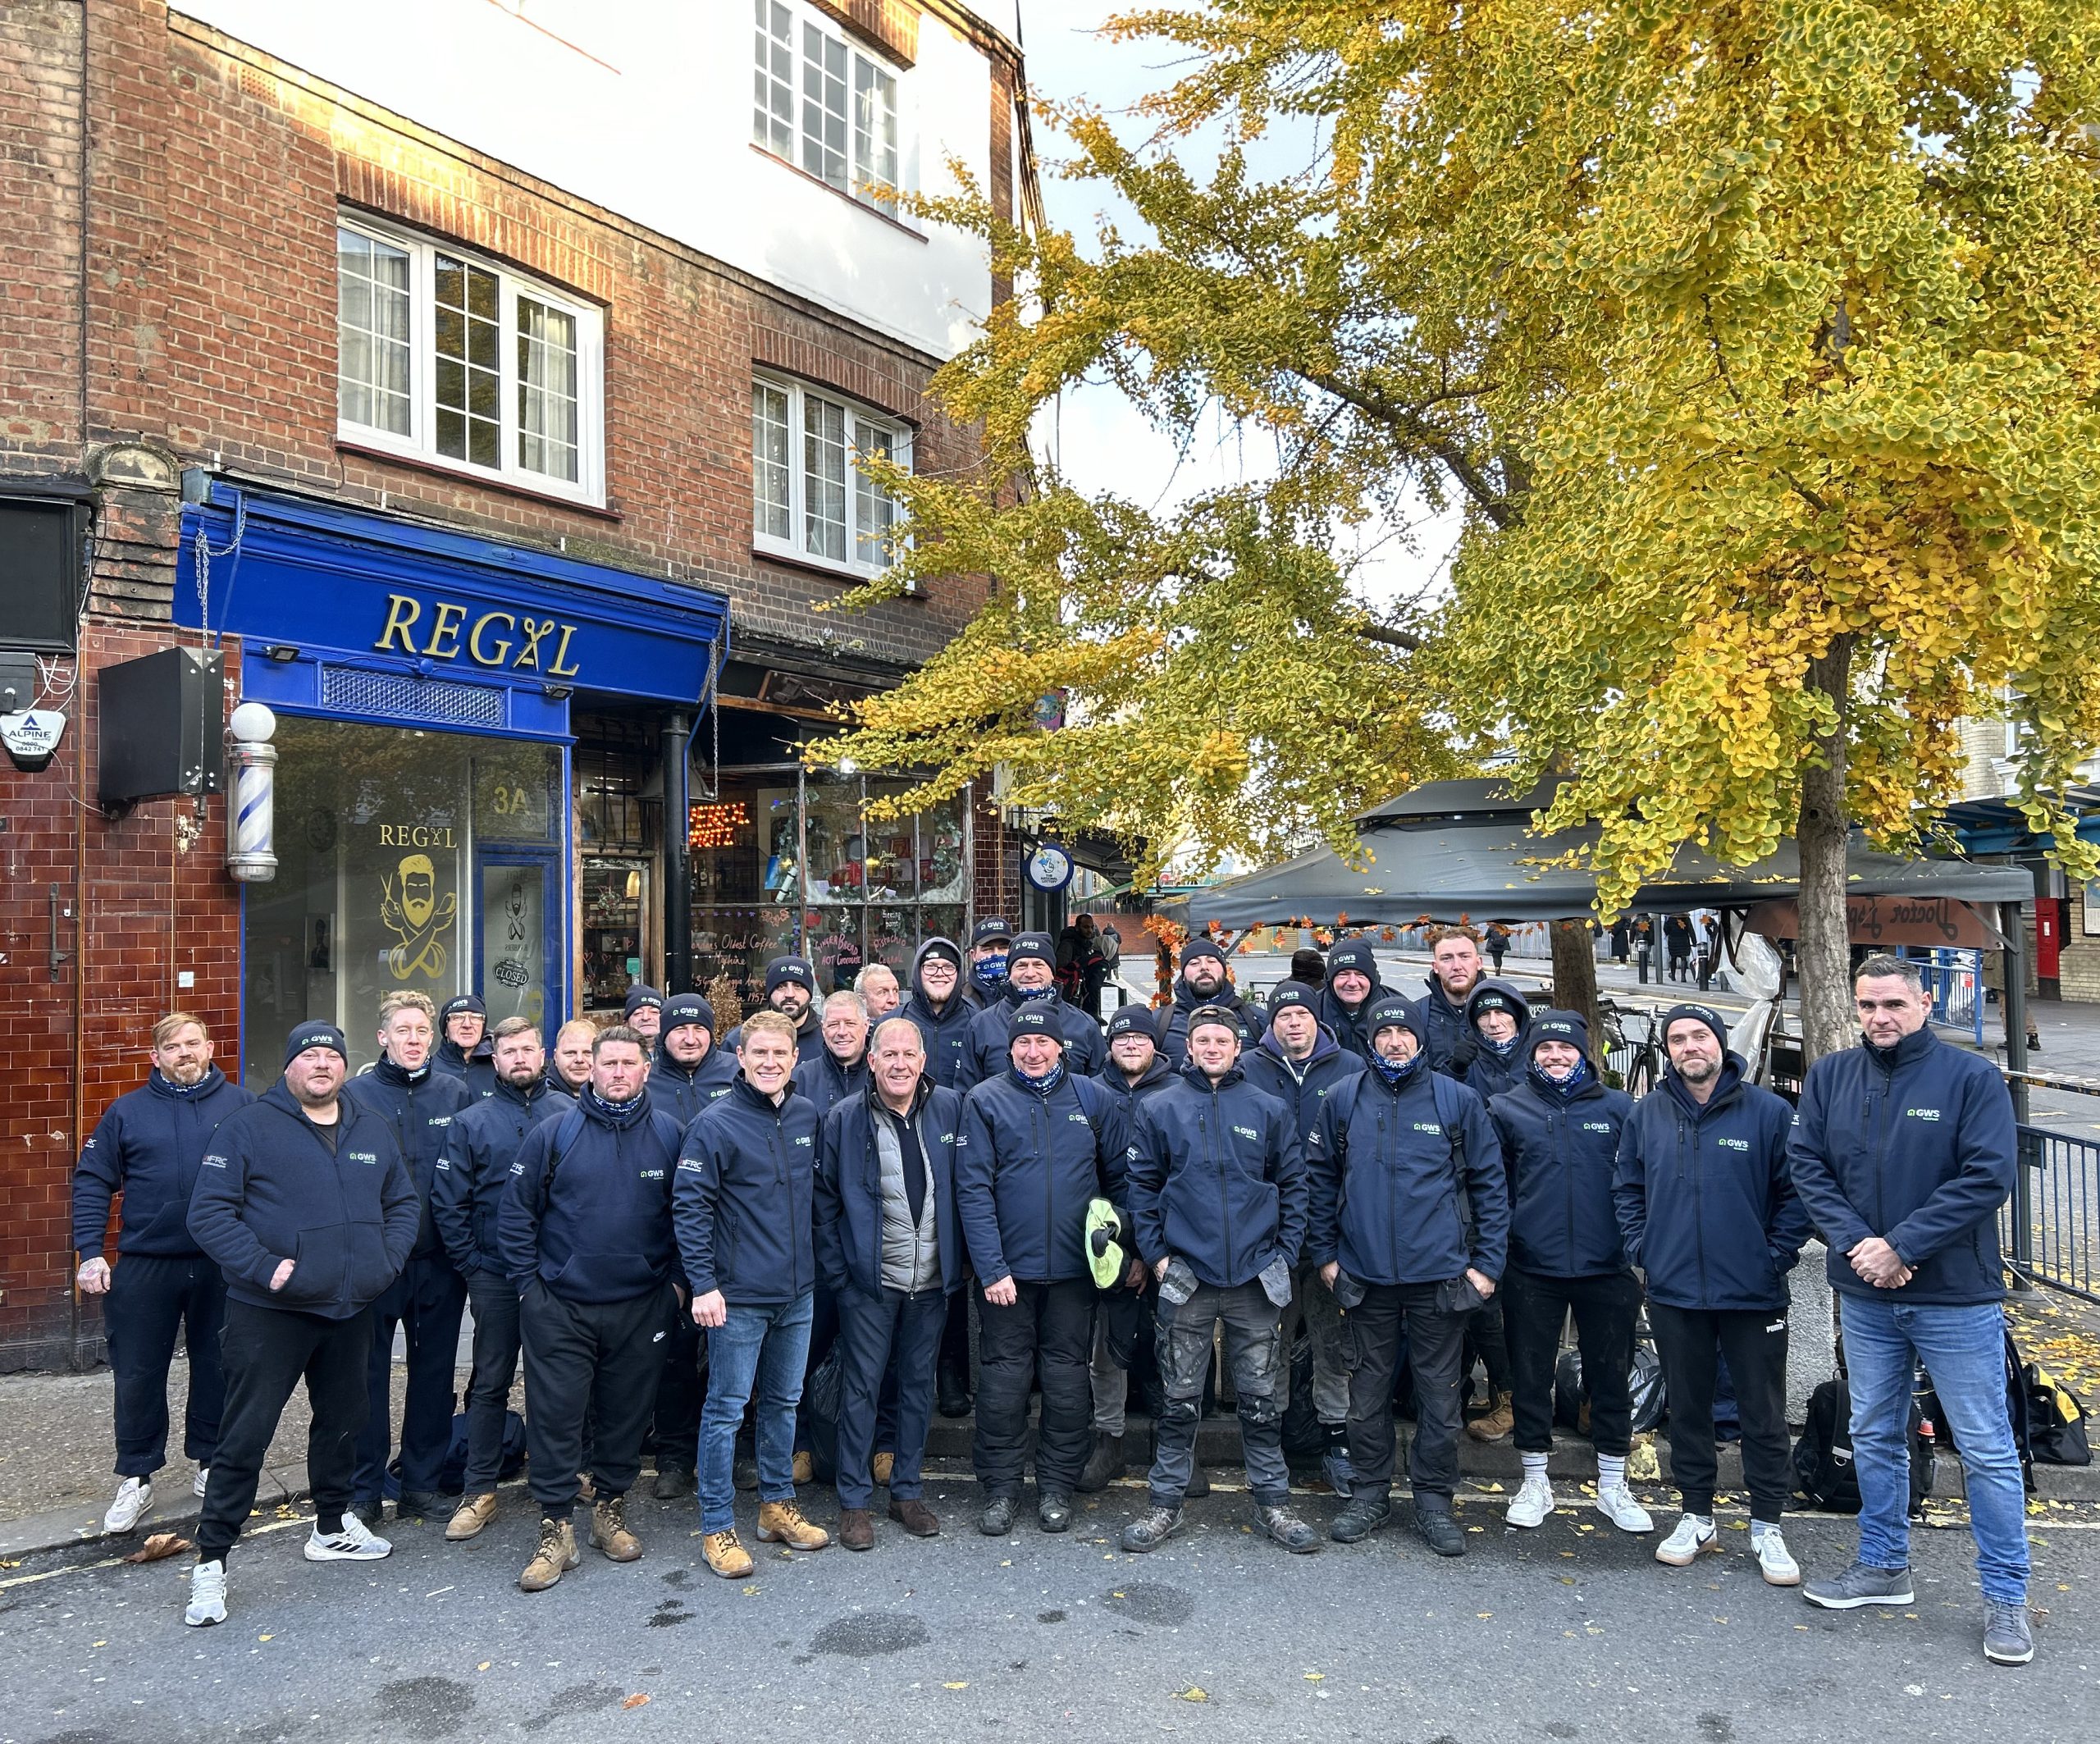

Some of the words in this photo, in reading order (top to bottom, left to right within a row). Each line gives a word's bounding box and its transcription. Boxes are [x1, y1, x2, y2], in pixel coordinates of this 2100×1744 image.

[374, 594, 580, 677] REGAL
[9, 730, 52, 738] ALPINE
[494, 786, 531, 815] 3A
[379, 824, 458, 849] REGAL
[750, 934, 778, 953] Coffee
[1338, 954, 1356, 962] GWS
[788, 966, 805, 974] GWS
[495, 966, 527, 984] CLOSED
[1281, 991, 1299, 999] GWS
[1025, 1014, 1044, 1022] GWS
[1114, 1018, 1130, 1028] GWS
[1550, 1022, 1572, 1031] GWS
[1915, 1108, 1940, 1117] GWS
[1240, 1127, 1258, 1138] GWS
[1422, 1124, 1440, 1132] GWS
[1727, 1139, 1749, 1148] GWS
[357, 1153, 377, 1162] GWS
